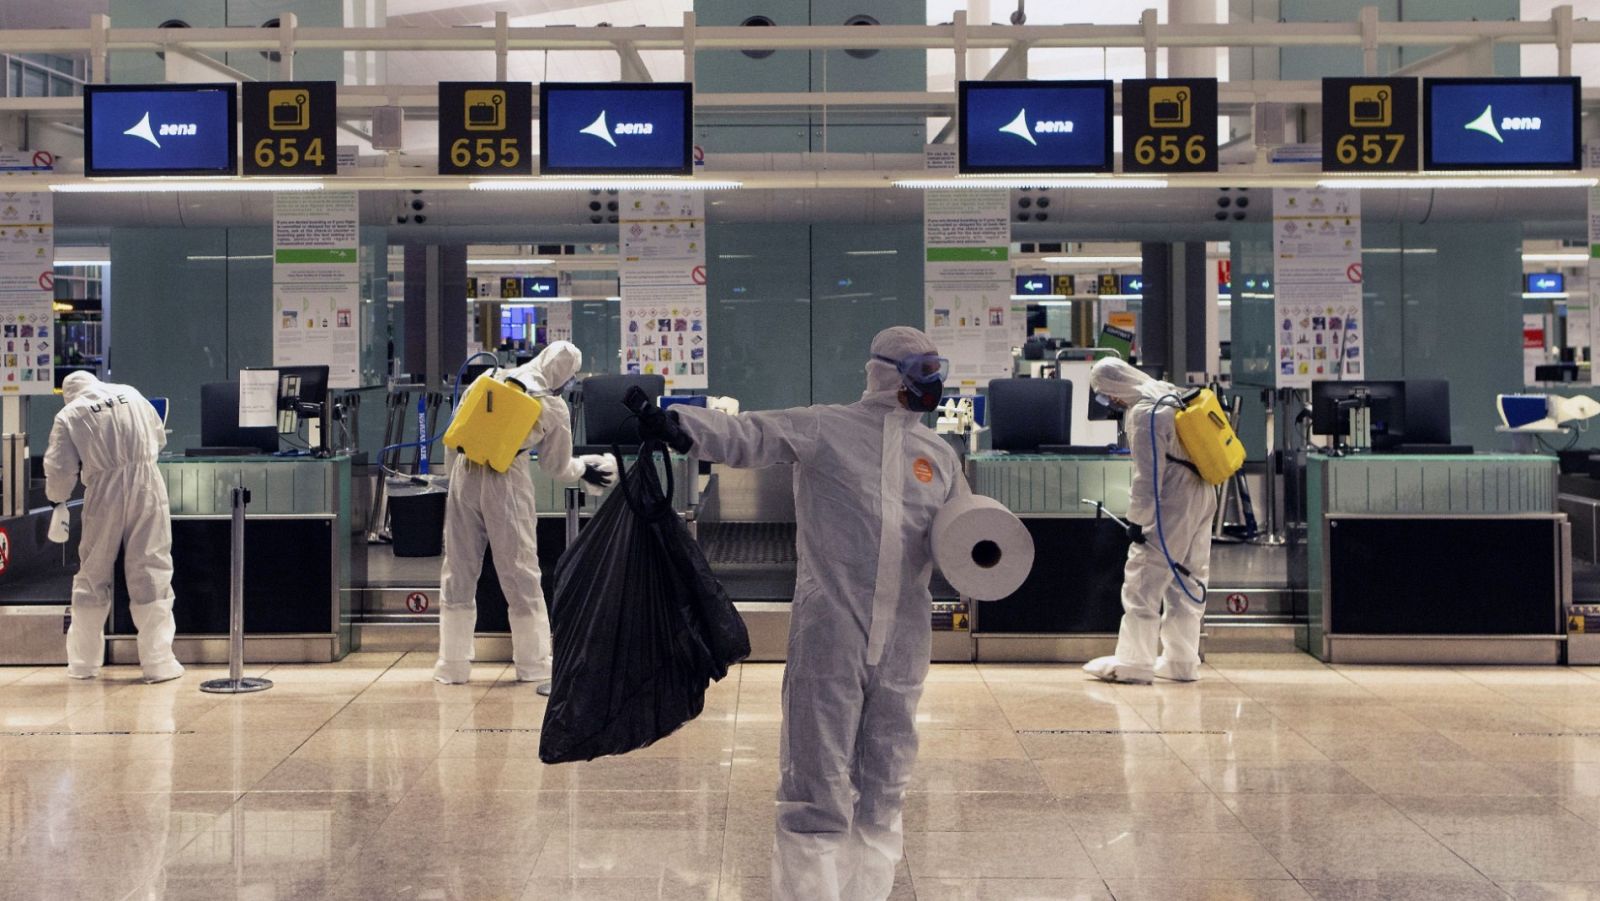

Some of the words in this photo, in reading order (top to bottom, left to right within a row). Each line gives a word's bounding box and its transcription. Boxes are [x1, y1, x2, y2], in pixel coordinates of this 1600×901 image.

[159, 123, 198, 136] aena
[614, 122, 654, 135] aena
[1034, 120, 1075, 133] aena
[1501, 116, 1542, 130] aena
[254, 138, 325, 168] 654
[450, 138, 520, 168] 655
[1134, 135, 1206, 165] 656
[1335, 134, 1405, 164] 657
